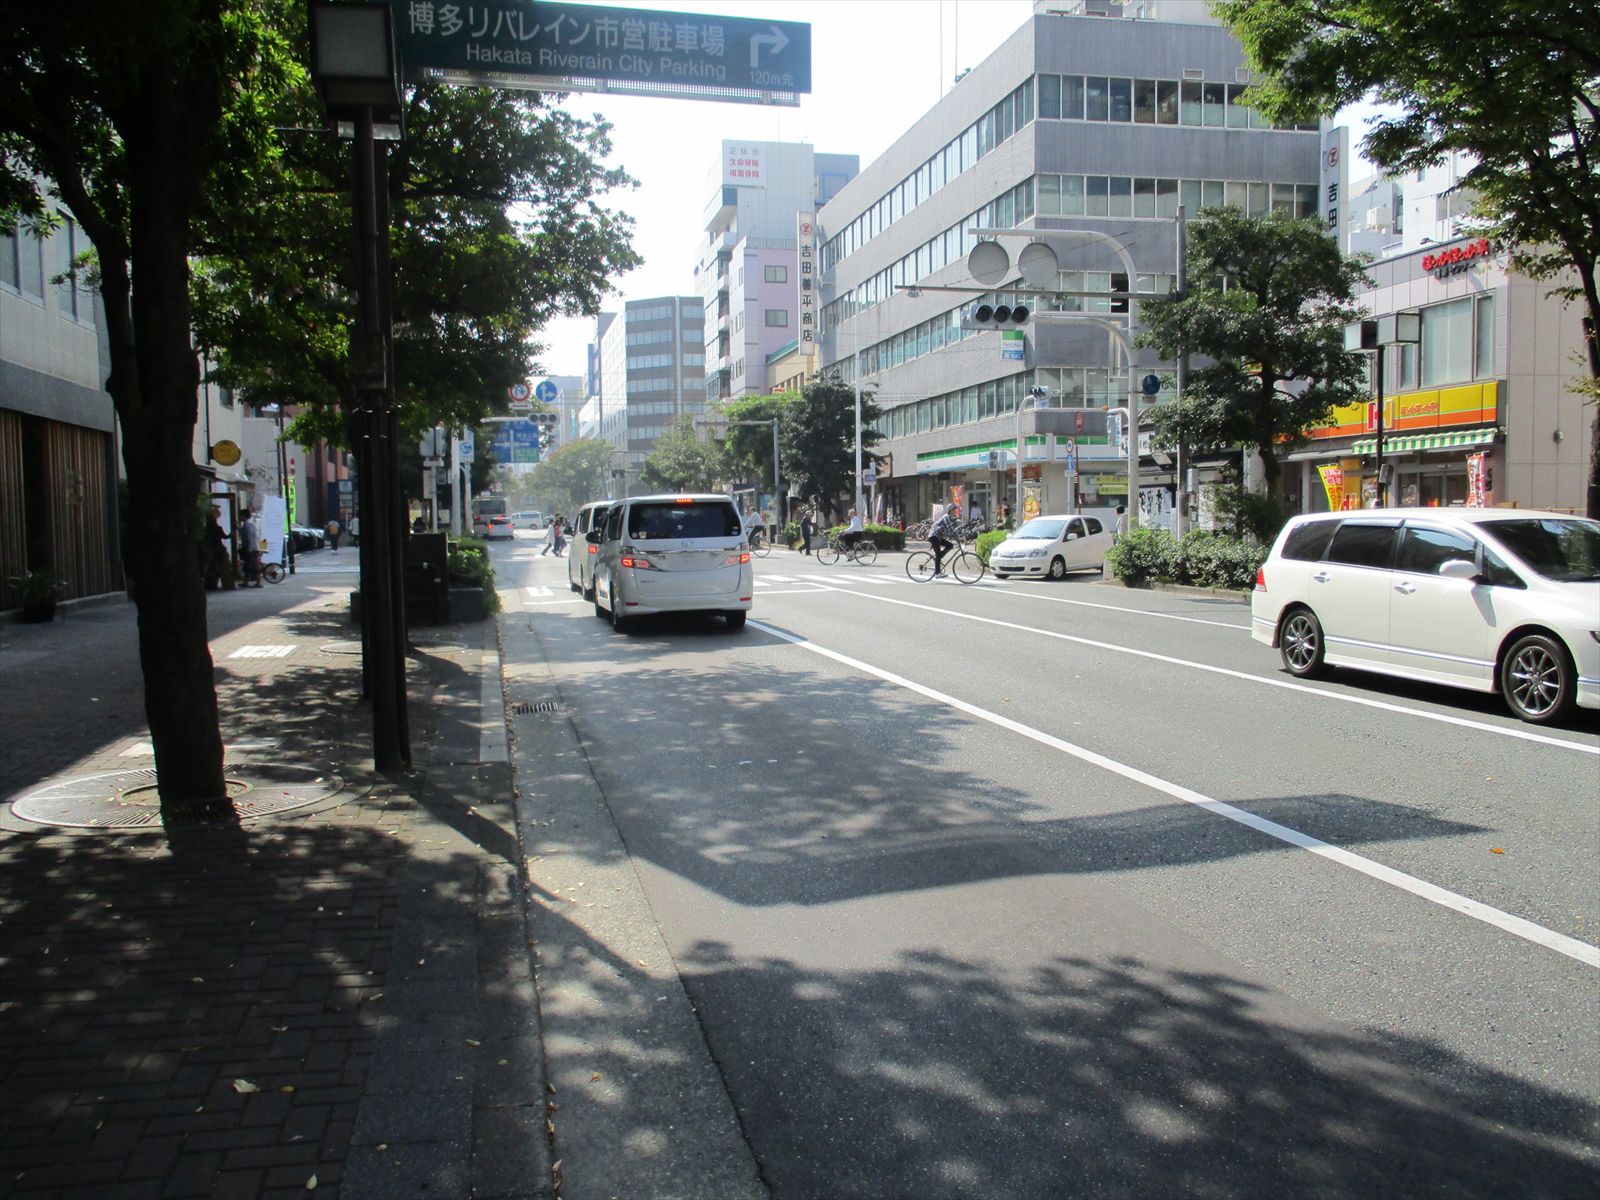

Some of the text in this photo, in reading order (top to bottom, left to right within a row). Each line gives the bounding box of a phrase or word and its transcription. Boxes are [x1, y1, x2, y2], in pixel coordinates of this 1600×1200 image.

[408, 1, 725, 57] 博多リバレイン市営駐車場
[466, 43, 726, 81] Hakata Riverain City Parking
[749, 70, 794, 87] 120m先
[1422, 238, 1490, 271] ほっかほっか亭
[801, 244, 813, 342] 吉田善平商店
